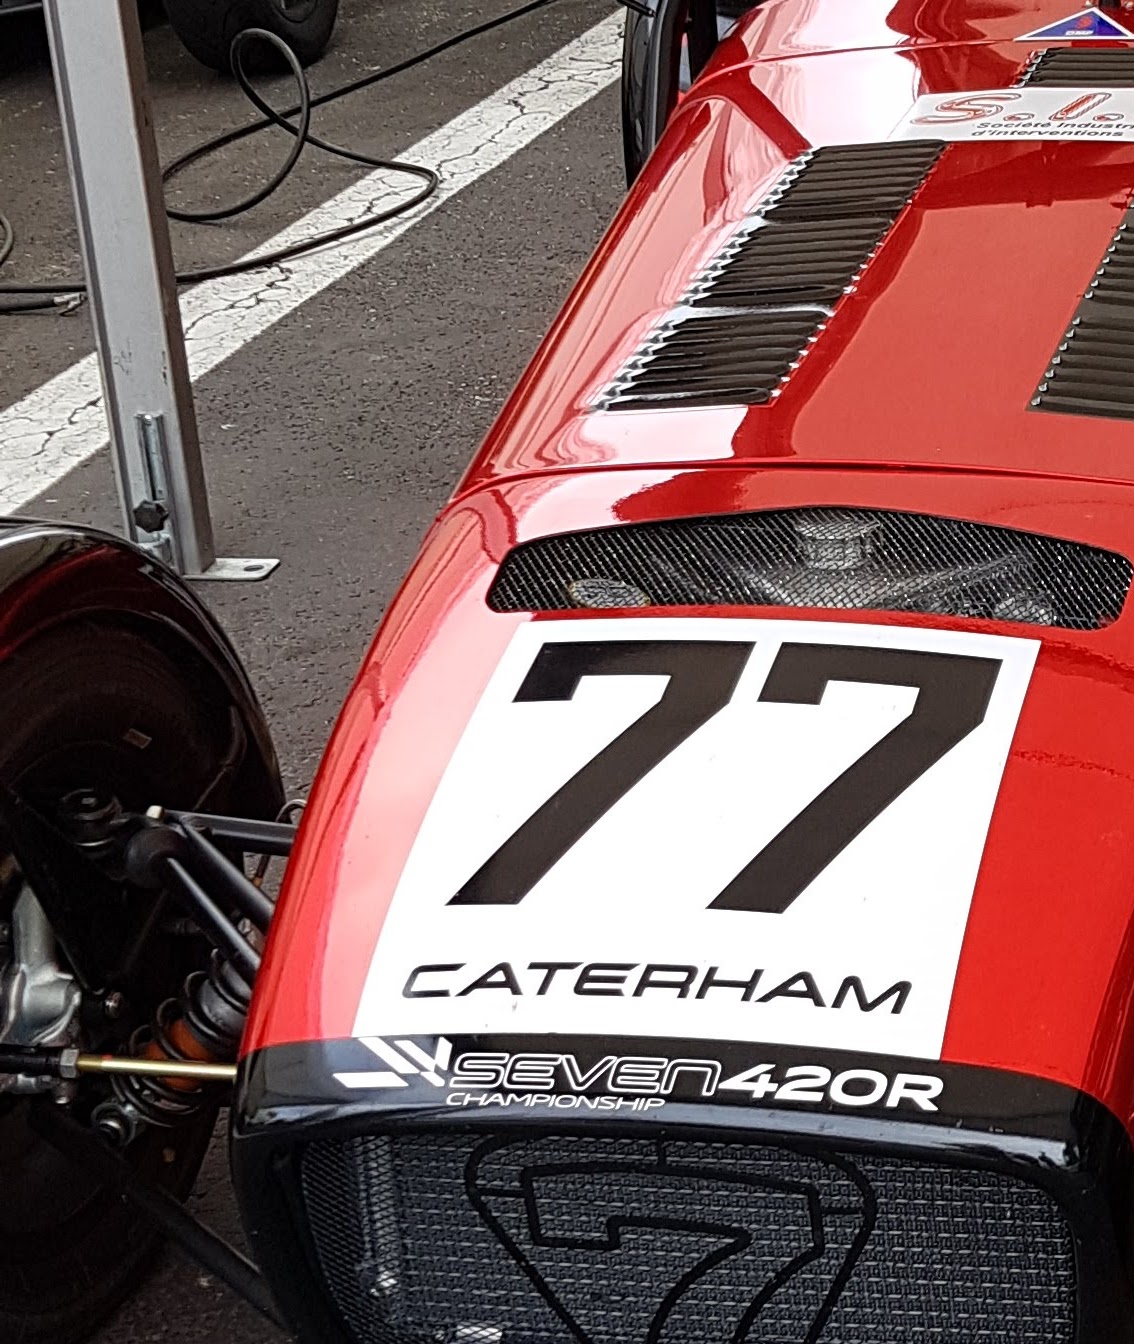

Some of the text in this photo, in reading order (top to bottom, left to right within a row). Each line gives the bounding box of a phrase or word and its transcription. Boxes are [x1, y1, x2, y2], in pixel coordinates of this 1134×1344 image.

[445, 640, 1003, 914] 77
[402, 961, 913, 1014] CATERHAM
[445, 1092, 666, 1112] CHAMPIONSHIP
